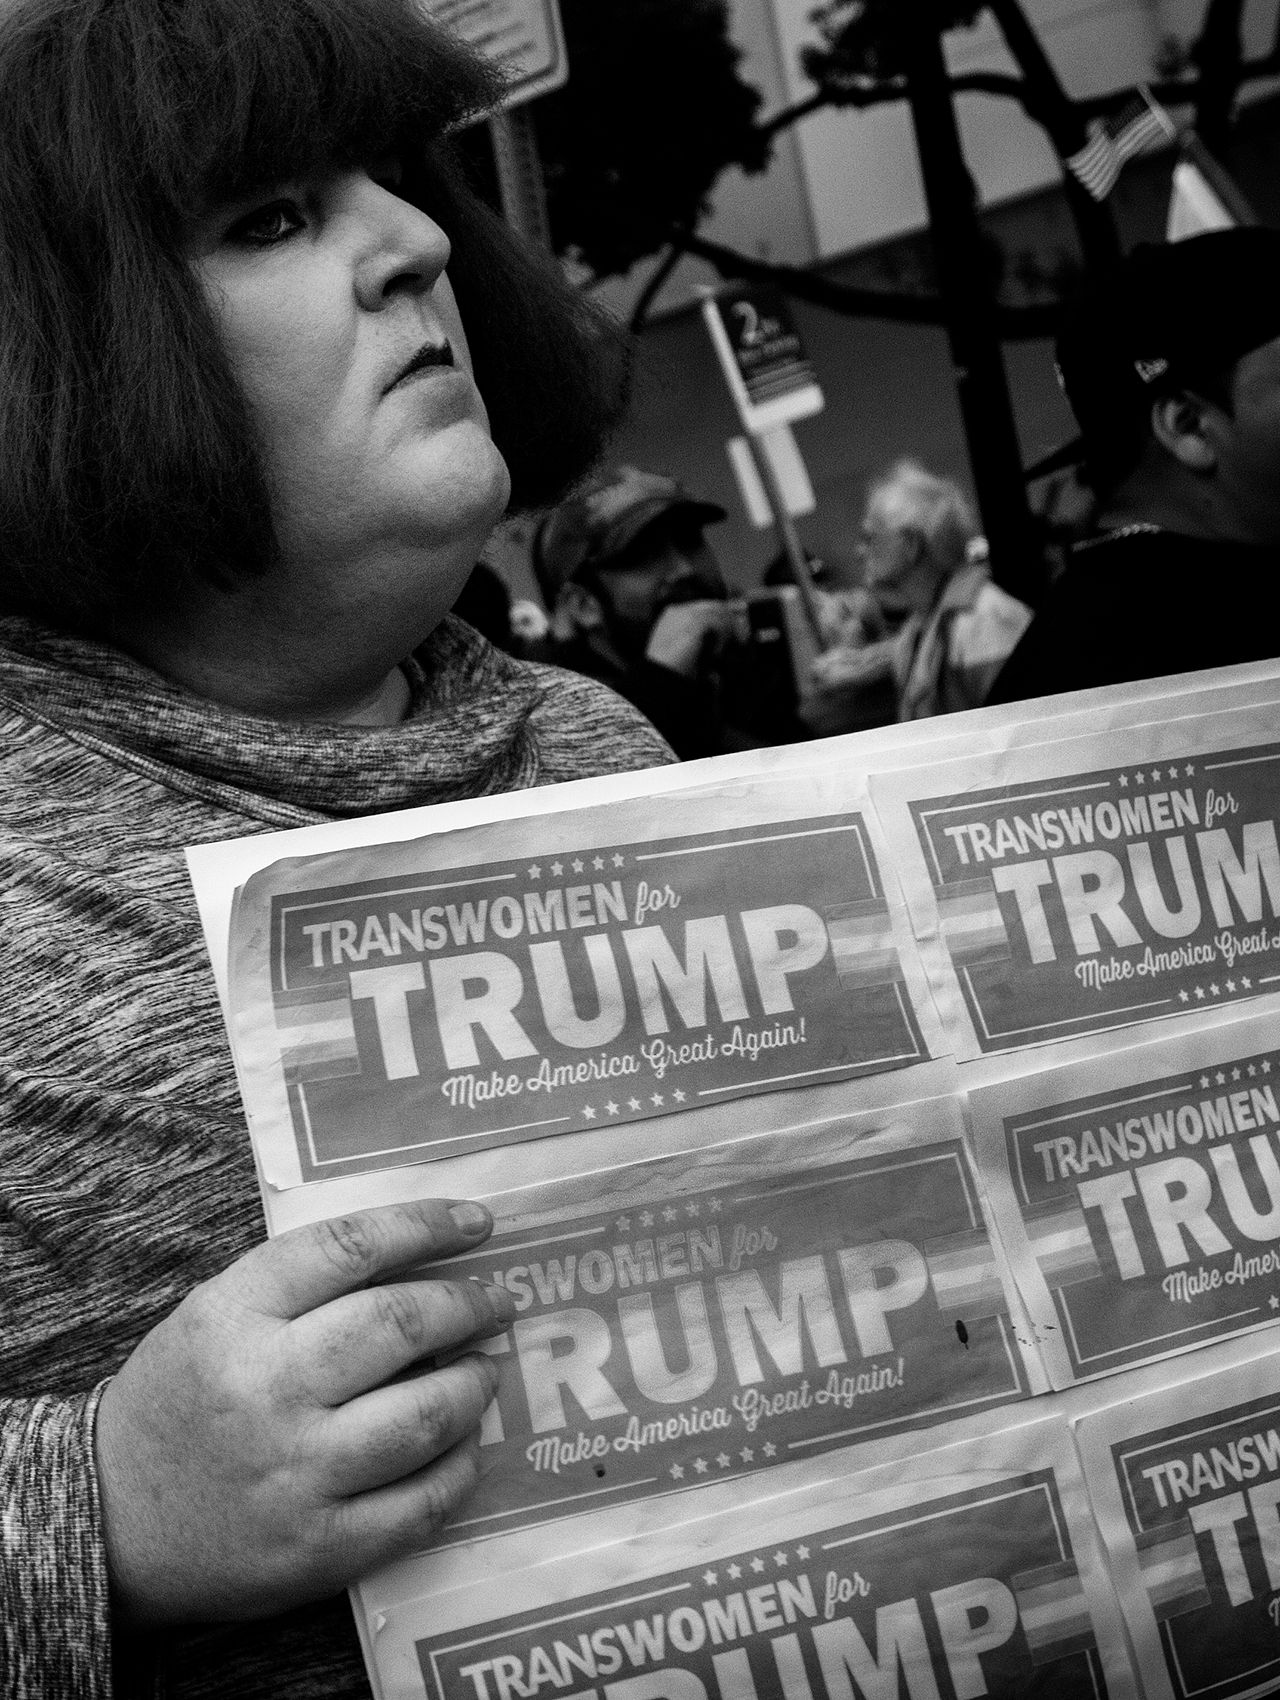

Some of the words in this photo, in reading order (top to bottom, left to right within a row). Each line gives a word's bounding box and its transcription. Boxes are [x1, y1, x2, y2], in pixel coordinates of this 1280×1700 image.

[942, 788, 1201, 865] TRANSWOMEN
[1204, 788, 1240, 828] for
[302, 880, 629, 969] TRANSWOMEN
[634, 881, 682, 926] for
[1073, 957, 1136, 992] Make
[1136, 942, 1217, 977] America
[1214, 927, 1270, 968] Great
[348, 902, 830, 1081] TRUMP
[441, 1070, 523, 1109] Make
[526, 1053, 641, 1093] America
[640, 1034, 719, 1080] Great
[721, 1017, 808, 1062] Again!
[1033, 1084, 1280, 1184] TRANSWOMEN
[1076, 1130, 1280, 1281] TRU
[492, 1225, 724, 1312] SWOMEN
[729, 1223, 778, 1272] for
[1161, 1266, 1223, 1304] Make
[525, 1432, 609, 1474] Make
[612, 1406, 732, 1453] America
[731, 1380, 814, 1433] Great
[814, 1357, 905, 1409] Again!
[459, 1574, 817, 1700] TRANSWOMEN
[823, 1570, 871, 1620] for
[554, 1576, 1019, 1700] UMP
